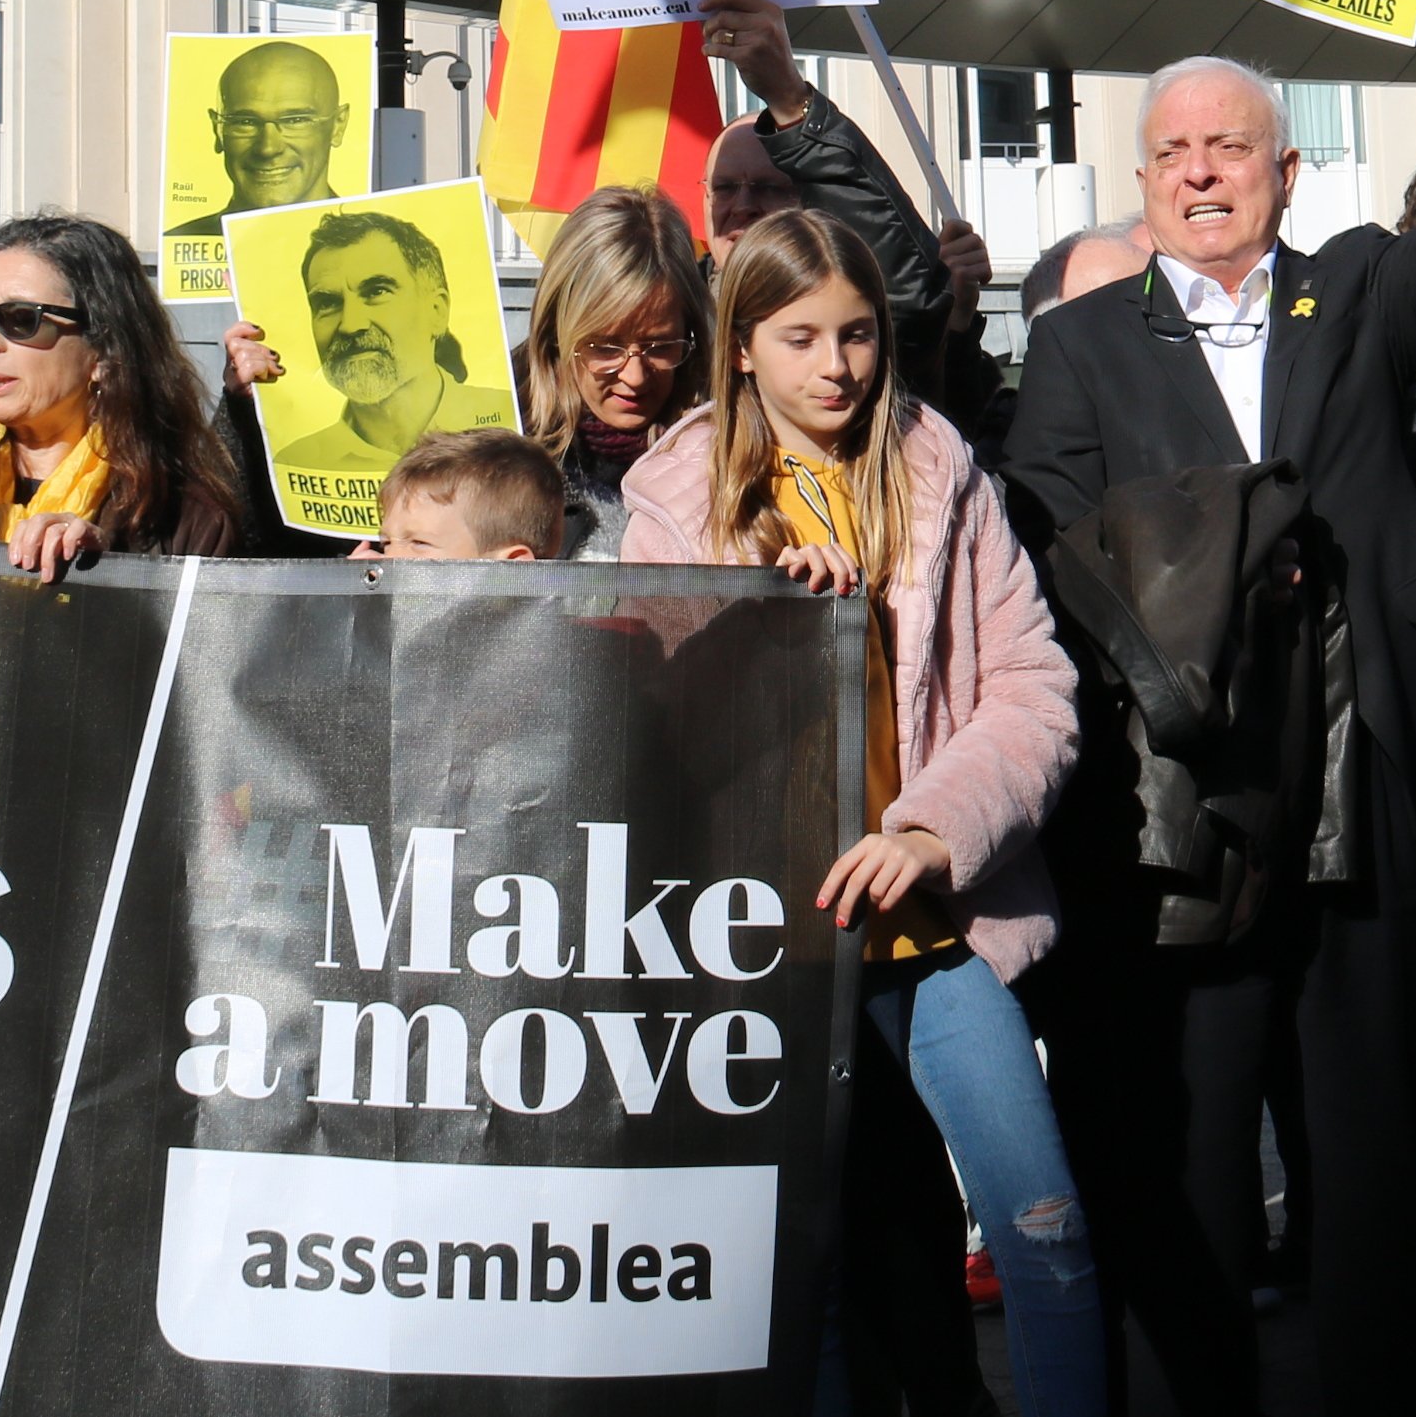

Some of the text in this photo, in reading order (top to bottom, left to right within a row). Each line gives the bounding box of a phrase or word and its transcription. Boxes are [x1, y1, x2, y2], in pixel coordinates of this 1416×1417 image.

[562, 0, 692, 24] makeamove.cat
[172, 194, 208, 203] Romeva
[174, 242, 210, 262] FREE
[180, 268, 229, 290] PRISO
[475, 412, 501, 426] Jordi
[288, 472, 331, 497] FREE
[174, 991, 784, 1116] a move
[240, 1222, 713, 1305] assemblea
